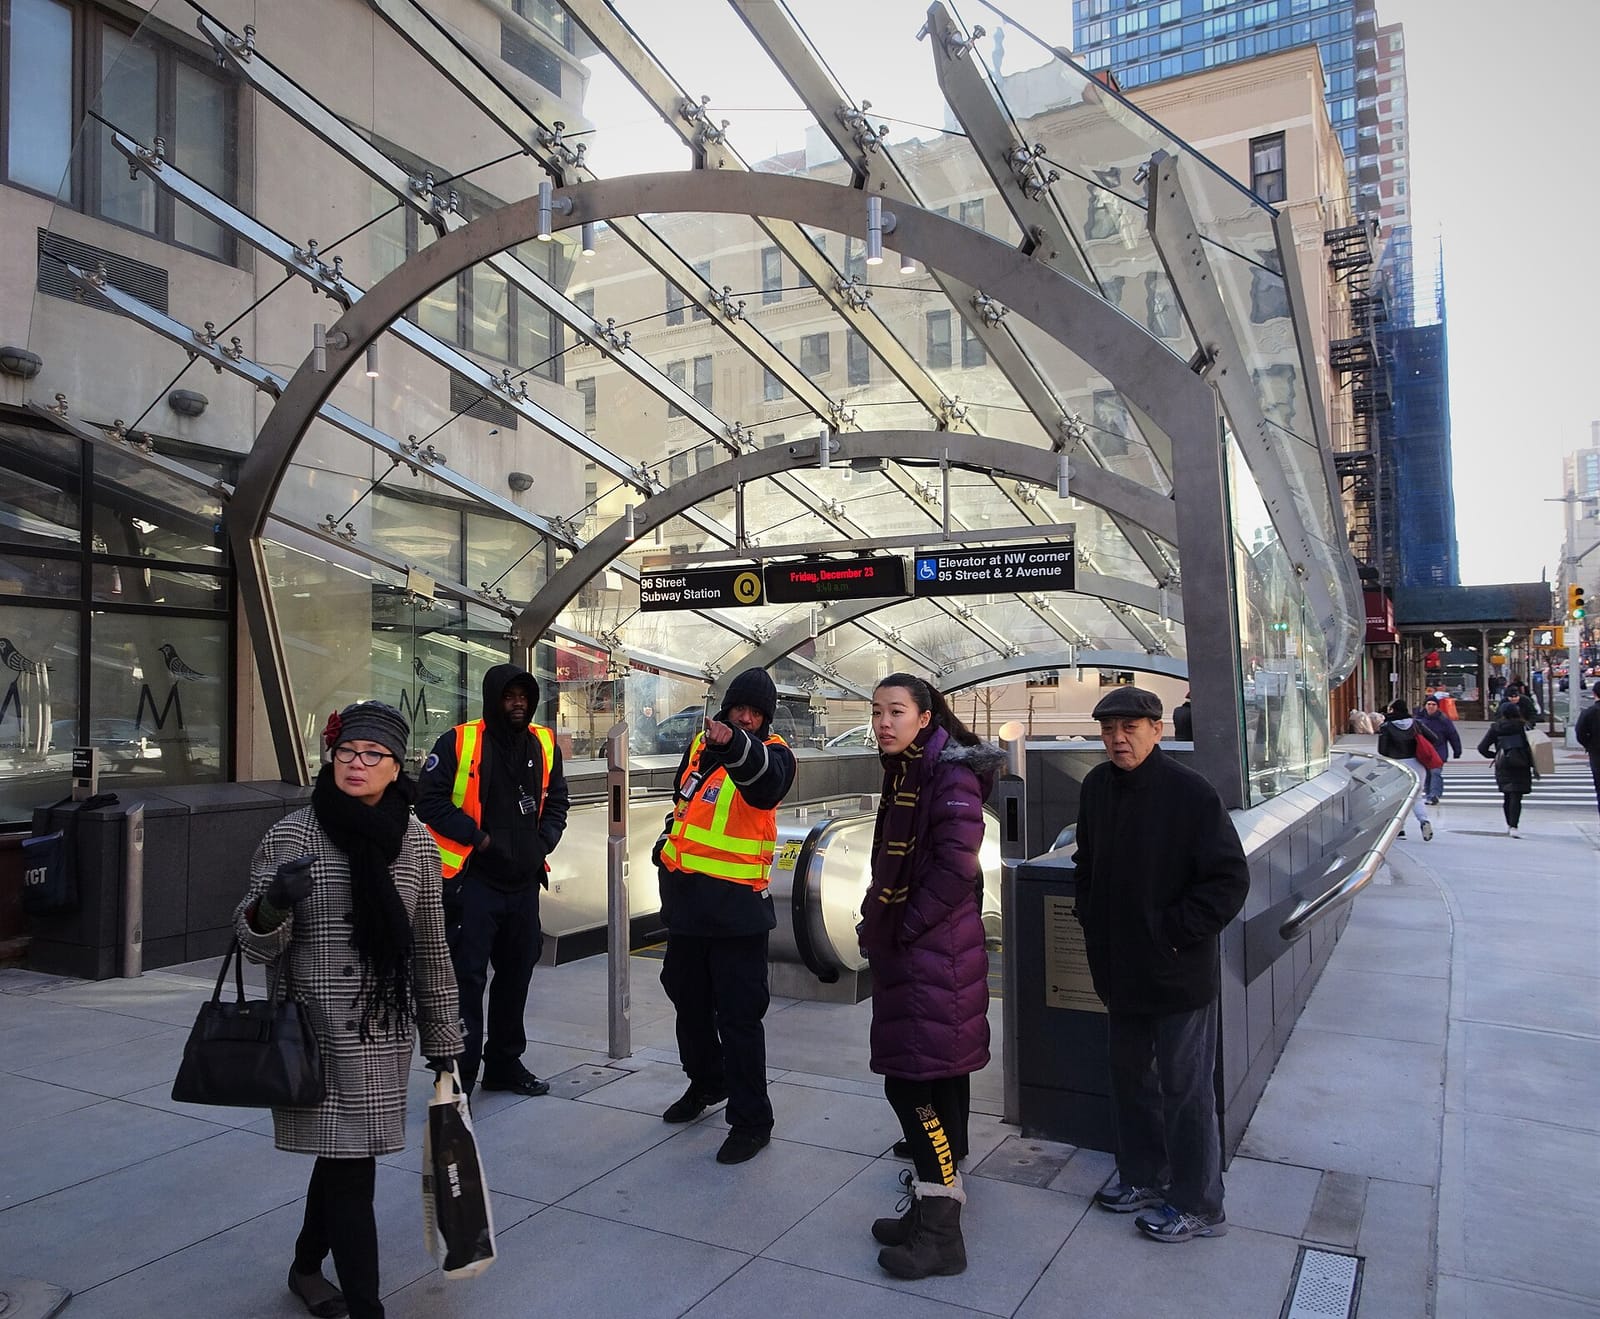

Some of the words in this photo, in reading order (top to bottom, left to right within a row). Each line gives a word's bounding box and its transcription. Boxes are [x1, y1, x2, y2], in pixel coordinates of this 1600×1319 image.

[939, 556, 986, 568] Elevator
[989, 555, 1001, 565] at
[1004, 553, 1026, 564] NW
[1029, 552, 1071, 563] corner
[790, 572, 820, 583] Friday,
[820, 569, 863, 580] December
[864, 567, 874, 577] 23
[938, 571, 952, 581] 95
[955, 568, 991, 580] Street
[993, 568, 1002, 578] &
[1005, 567, 1013, 578] 2
[1016, 566, 1062, 578] Avenue
[641, 578, 653, 589] 96
[655, 577, 687, 588] Street
[740, 578, 755, 597] Q
[641, 591, 681, 602] Subway
[683, 588, 721, 599] Station
